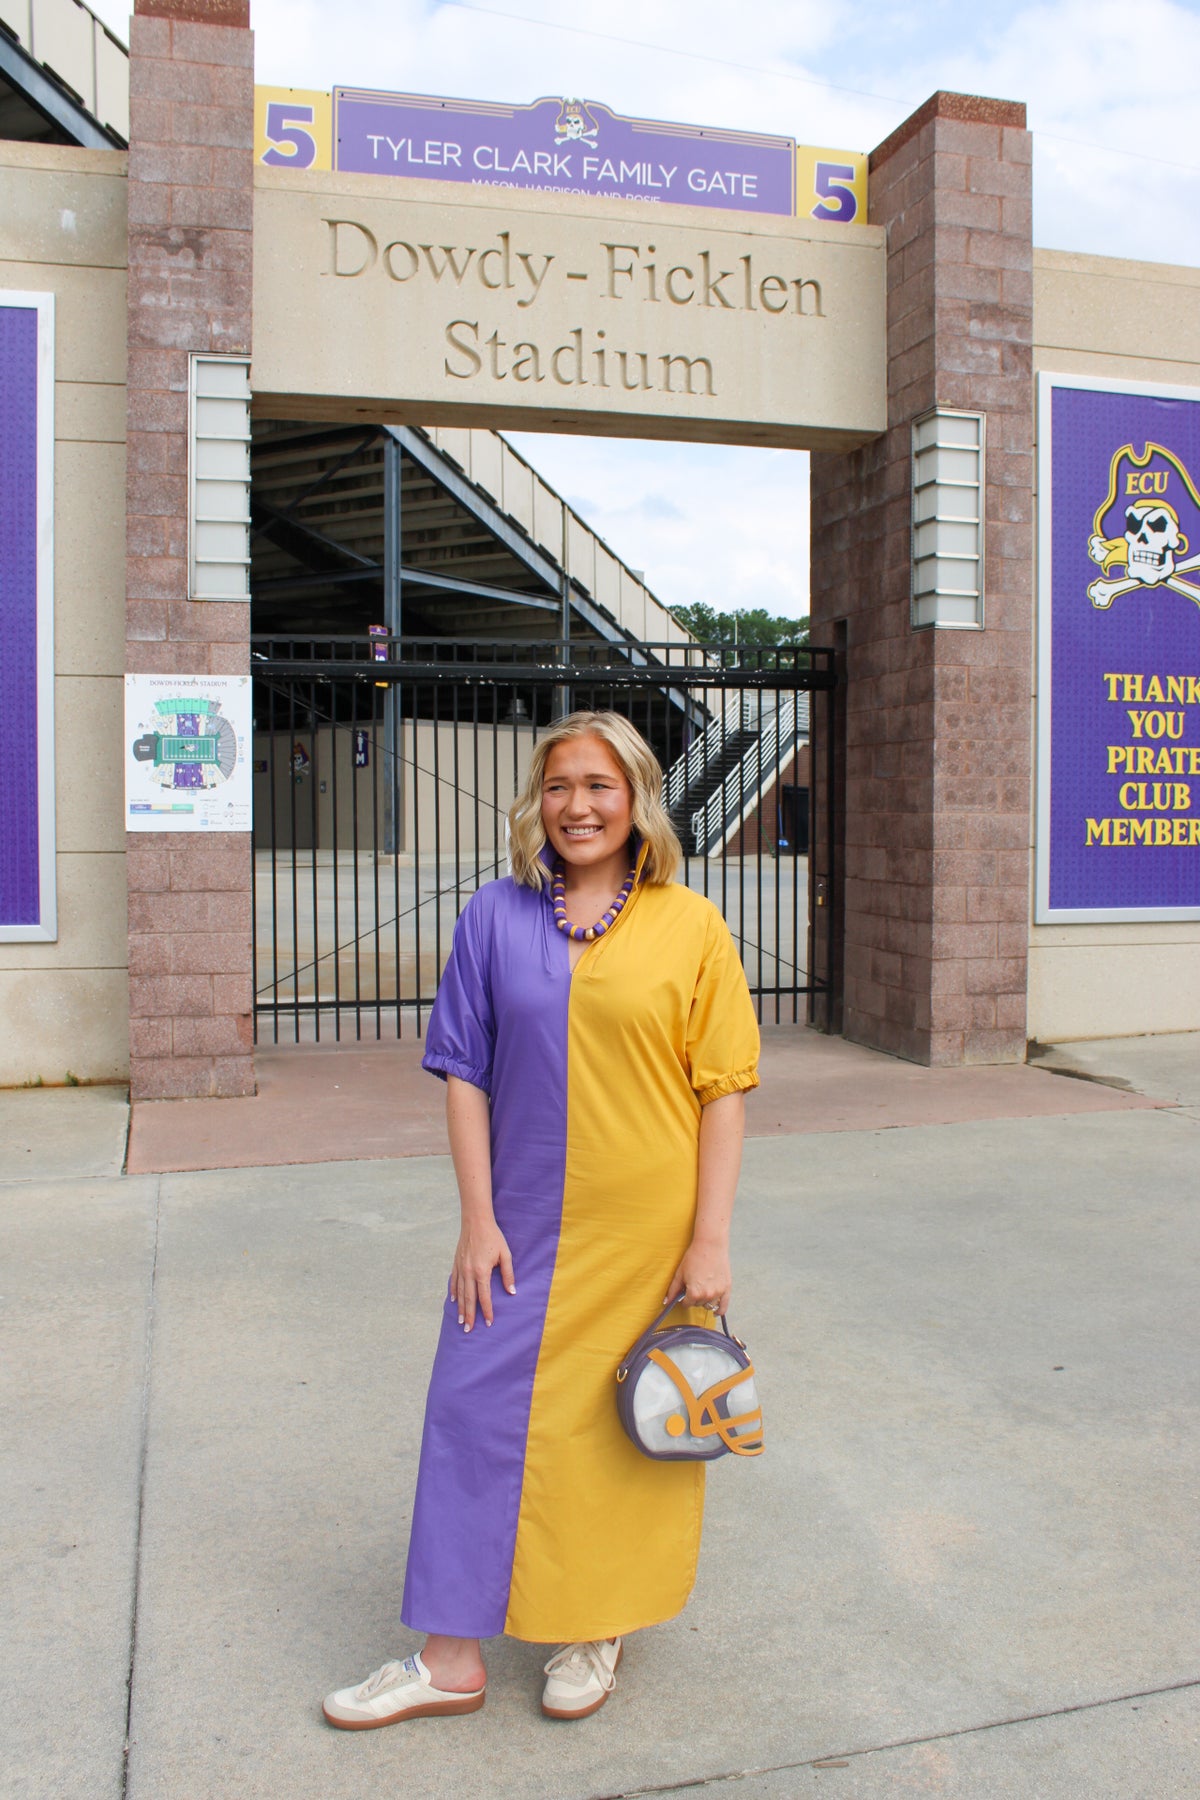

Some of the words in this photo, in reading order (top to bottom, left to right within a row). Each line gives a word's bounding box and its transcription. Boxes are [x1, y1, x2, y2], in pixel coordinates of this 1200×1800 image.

[261, 103, 316, 169] 5
[366, 135, 462, 167] TYLER
[473, 146, 572, 178] CLARK
[583, 156, 678, 188] FAMILY
[687, 168, 758, 198] GATE
[810, 162, 857, 223] 5
[444, 319, 718, 397] Stadium
[1125, 471, 1170, 495] ECU
[1103, 673, 1200, 705] THANK
[1126, 710, 1186, 739] YOU
[1106, 745, 1200, 775] PIRATE
[1118, 781, 1191, 811] CLUB
